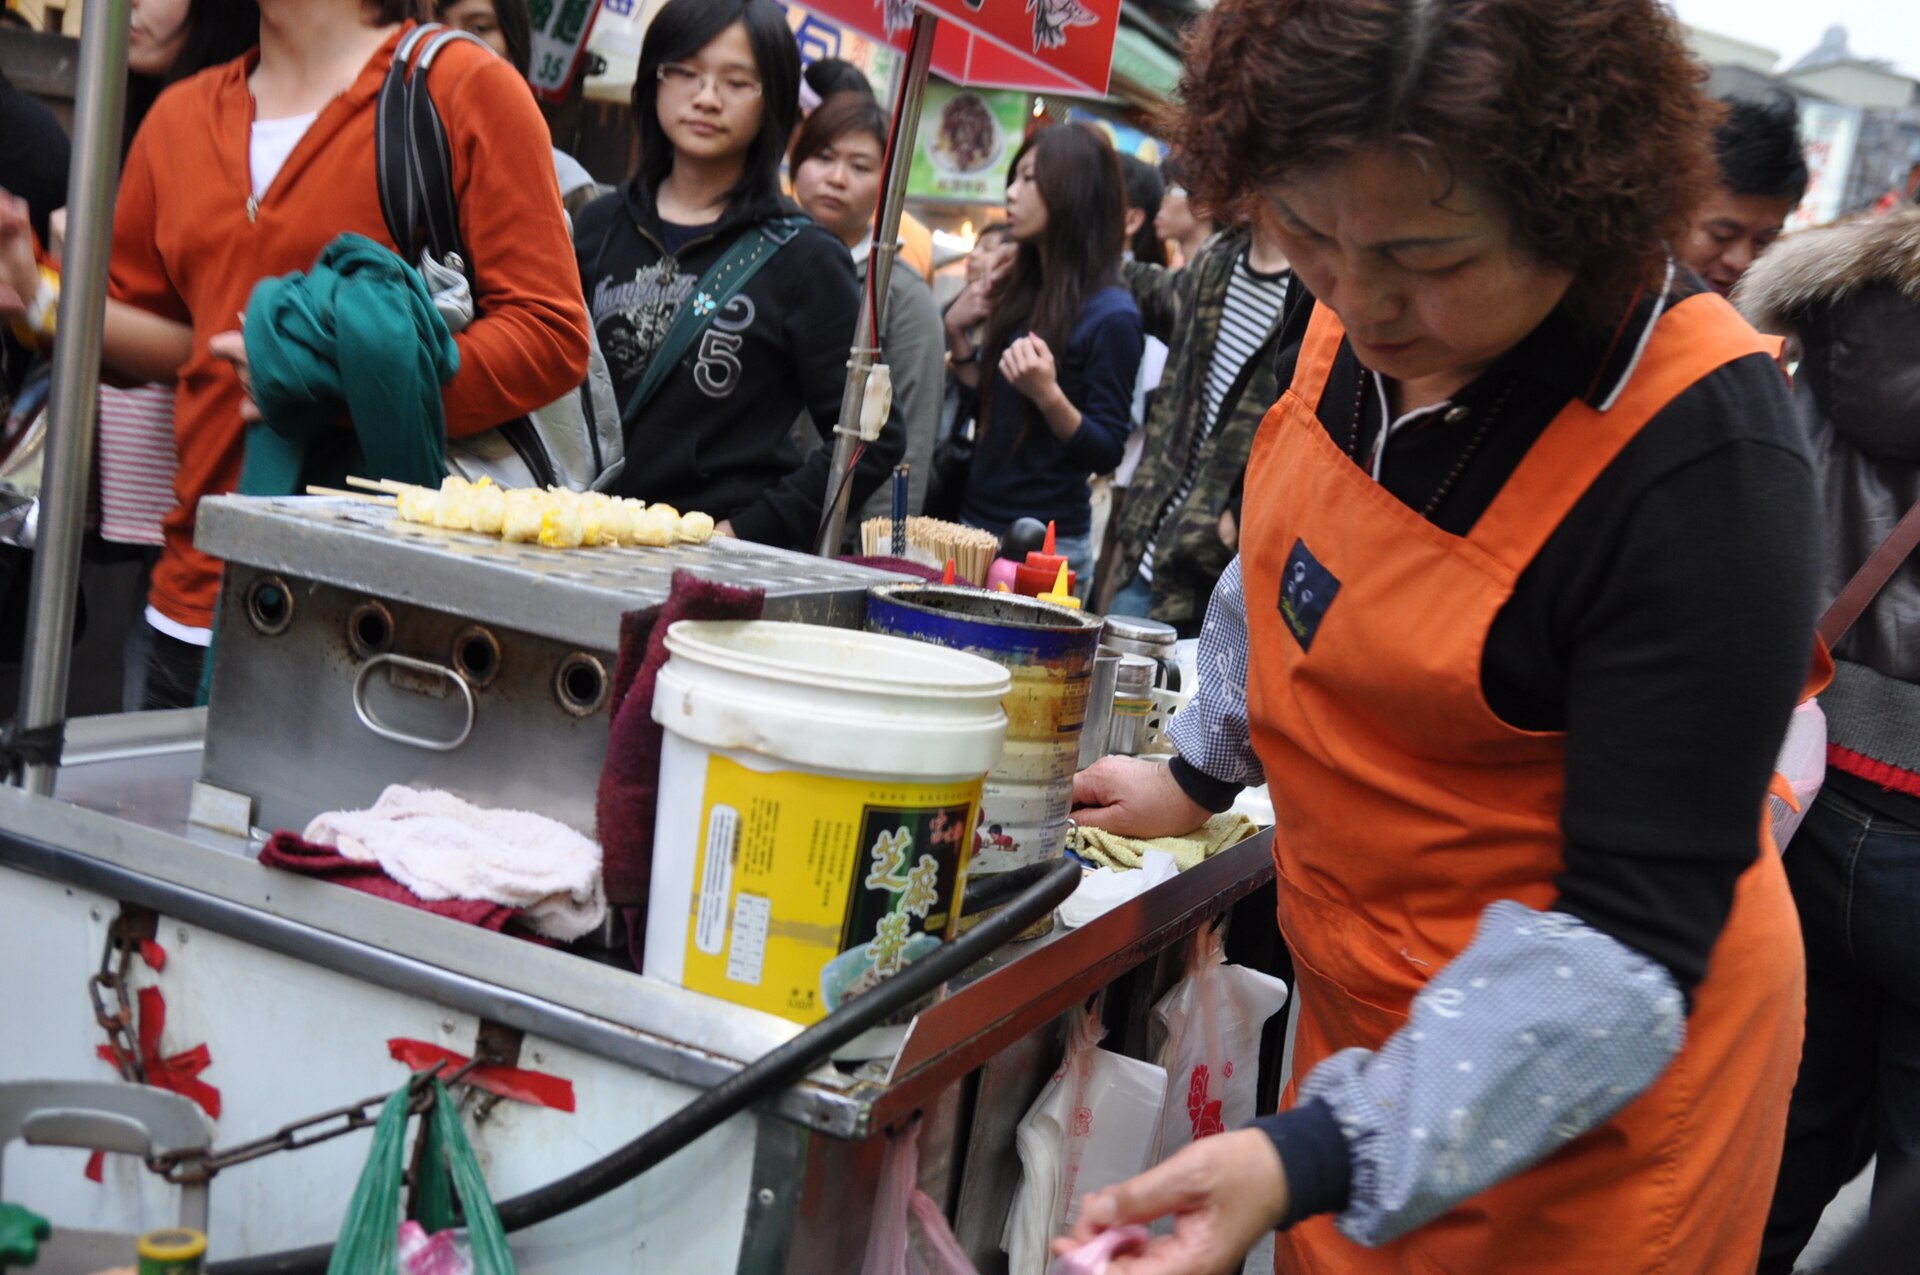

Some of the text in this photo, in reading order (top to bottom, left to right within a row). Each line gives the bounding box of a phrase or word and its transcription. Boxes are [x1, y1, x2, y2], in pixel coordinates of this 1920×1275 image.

[537, 53, 564, 83] 35
[865, 825, 939, 976] 芝麻醬
